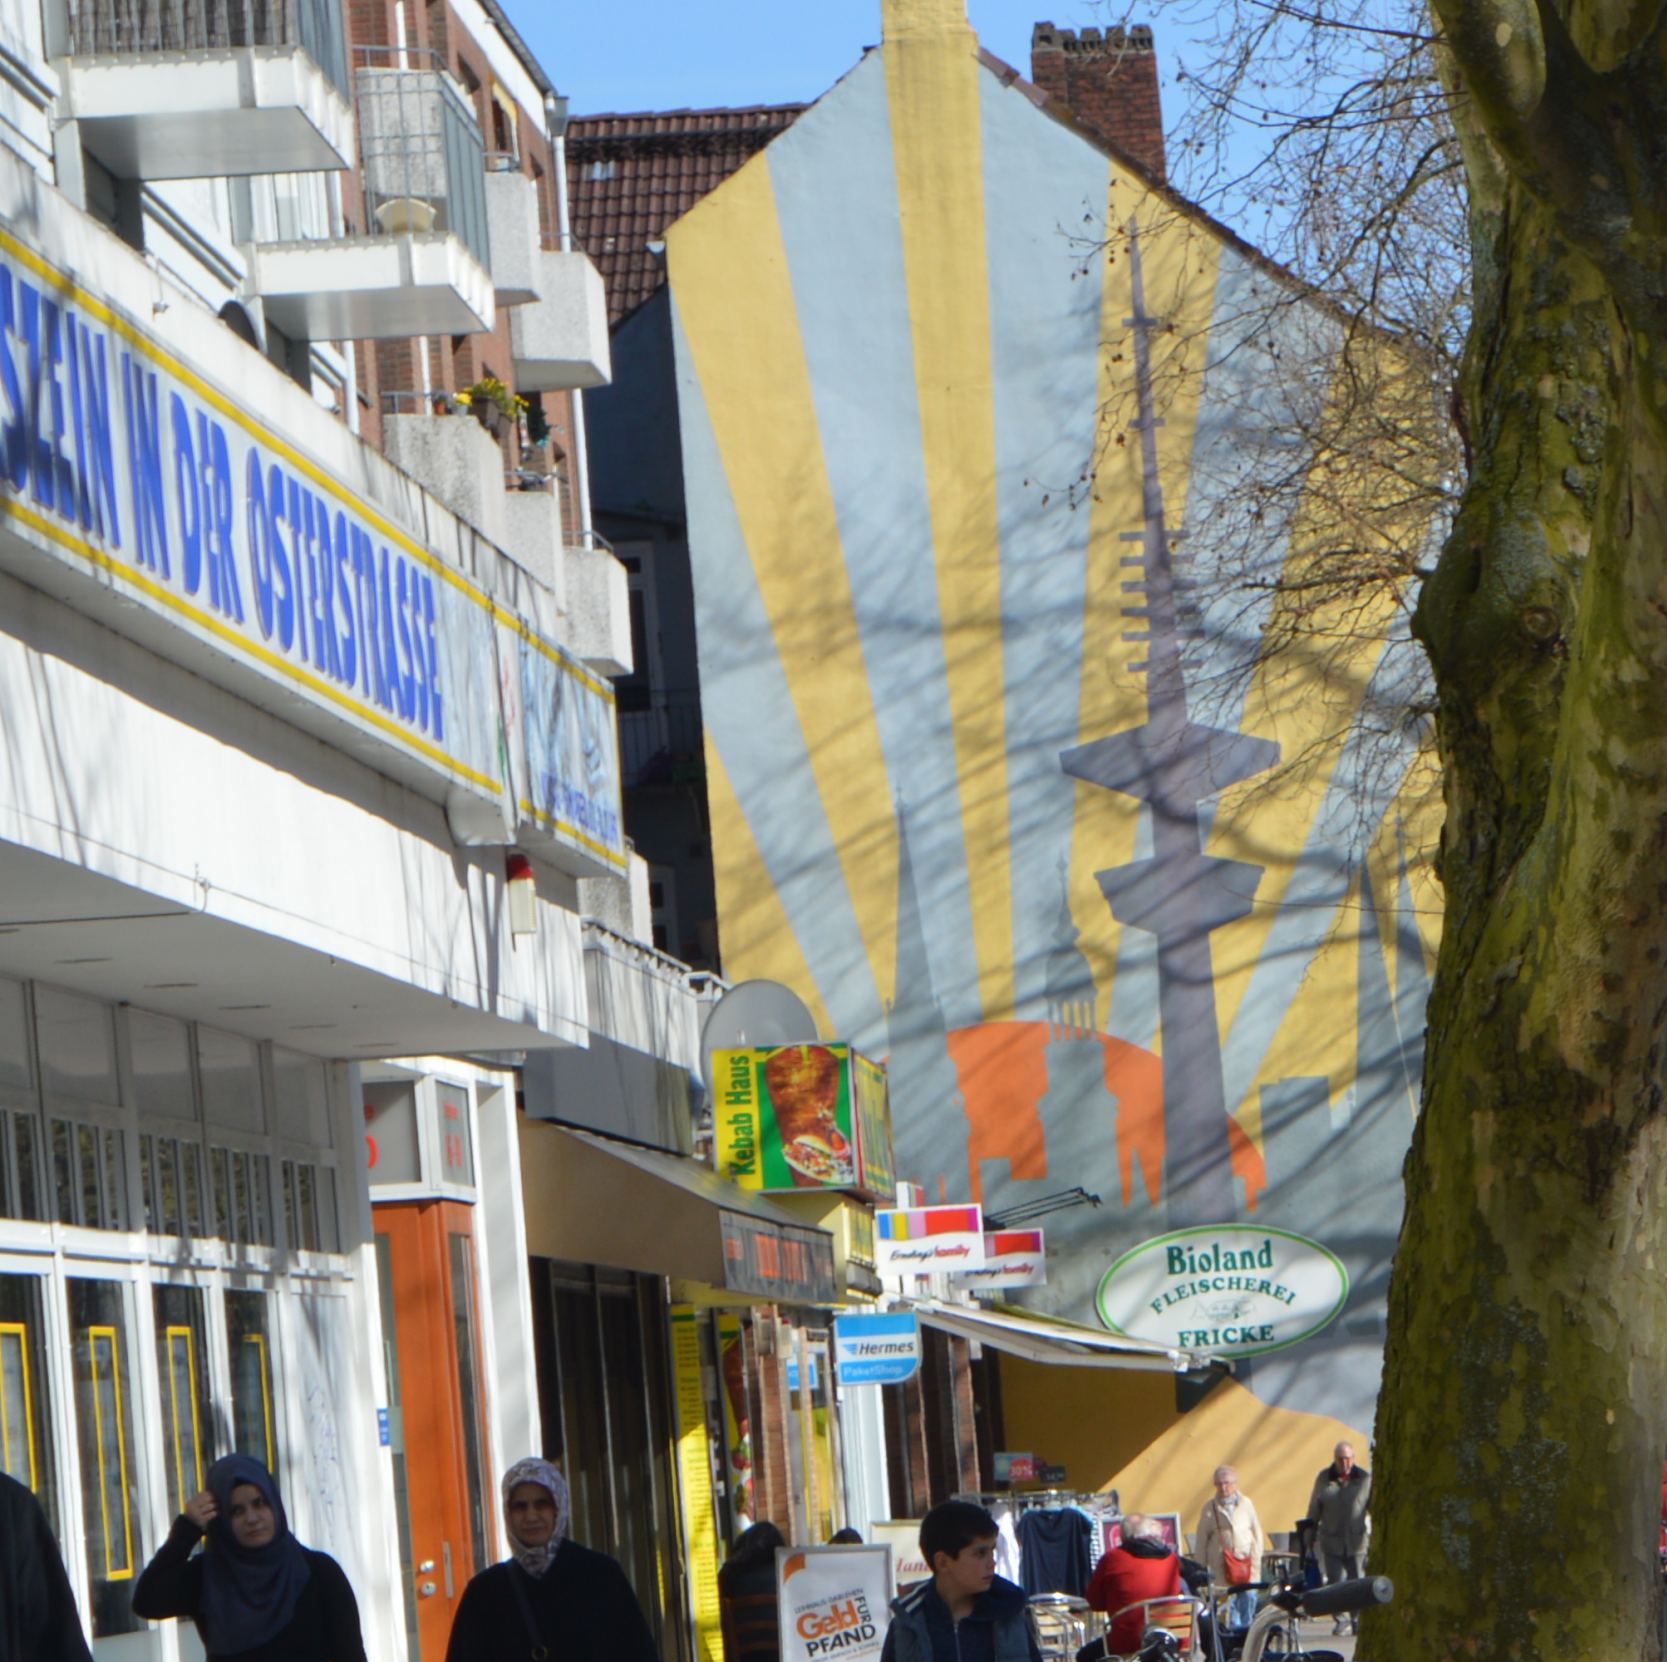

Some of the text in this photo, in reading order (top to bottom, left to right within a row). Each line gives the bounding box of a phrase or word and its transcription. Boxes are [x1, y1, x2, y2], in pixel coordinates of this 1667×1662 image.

[120, 351, 171, 581] IN
[170, 390, 245, 625] DER
[246, 446, 444, 742] OSTERSTRASSE
[725, 1055, 753, 1106] Haus
[727, 1112, 756, 1177] Kebab
[933, 1243, 971, 1258] family
[1166, 1239, 1274, 1276] Bioland
[1150, 1276, 1297, 1315] FLEISCHEREI
[858, 1340, 914, 1356] Hermes
[1177, 1324, 1275, 1348] FRICKE
[842, 1362, 904, 1379] PaketShop
[796, 1600, 860, 1641] Geld
[806, 1624, 876, 1659] PFAND
